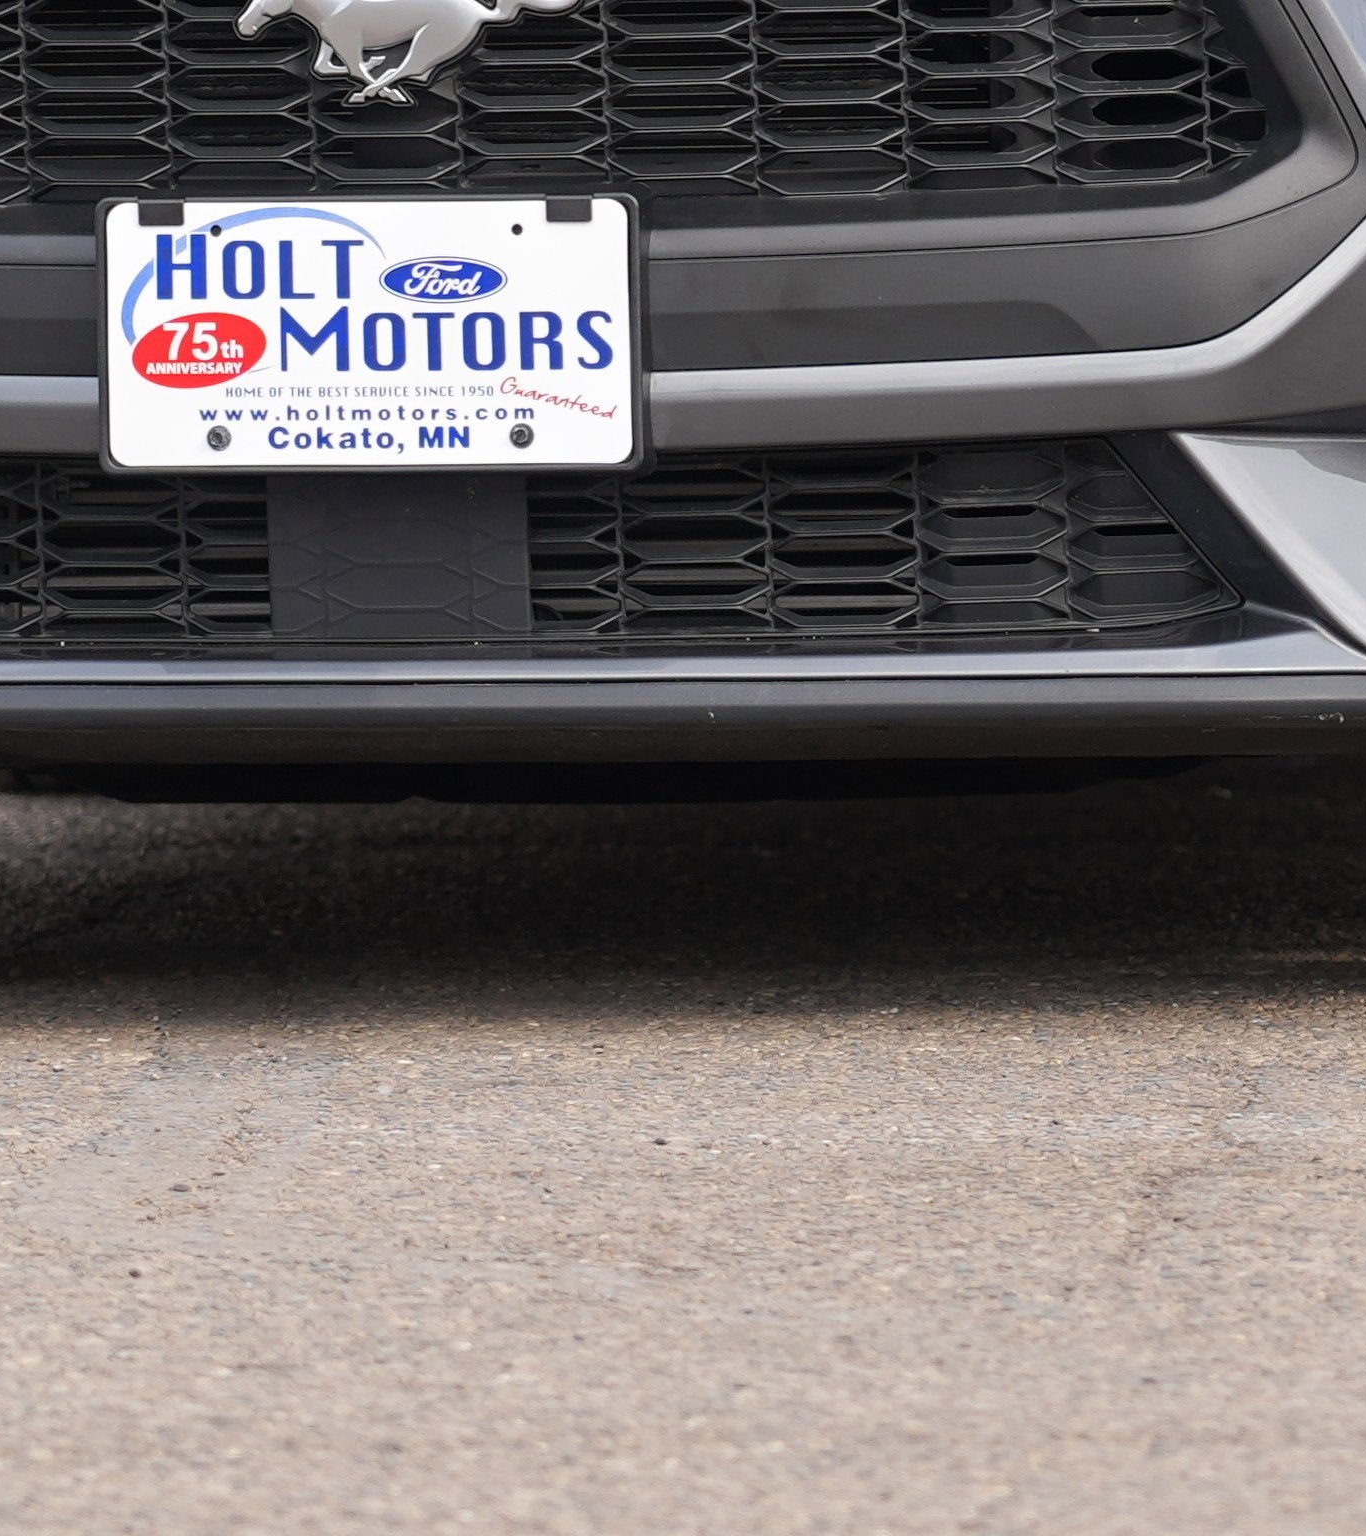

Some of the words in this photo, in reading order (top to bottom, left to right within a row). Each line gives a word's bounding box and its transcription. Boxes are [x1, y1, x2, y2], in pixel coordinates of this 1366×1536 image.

[156, 233, 365, 300] HOLT
[403, 262, 482, 296] Ford
[162, 321, 244, 362] 75th
[280, 306, 614, 372] MOTORS
[145, 362, 243, 376] ANNIVERSARY
[225, 387, 264, 398] HOME
[269, 387, 284, 398] OF
[289, 387, 313, 398] THE
[318, 386, 350, 398] BEST
[354, 386, 410, 397] SERVICE
[414, 386, 455, 397] SINCE
[461, 385, 495, 397] 1950
[499, 376, 618, 420] Guaranteed
[199, 405, 535, 421] www.holtmotors.com
[268, 426, 405, 454] Cokato,
[418, 426, 470, 449] MN
